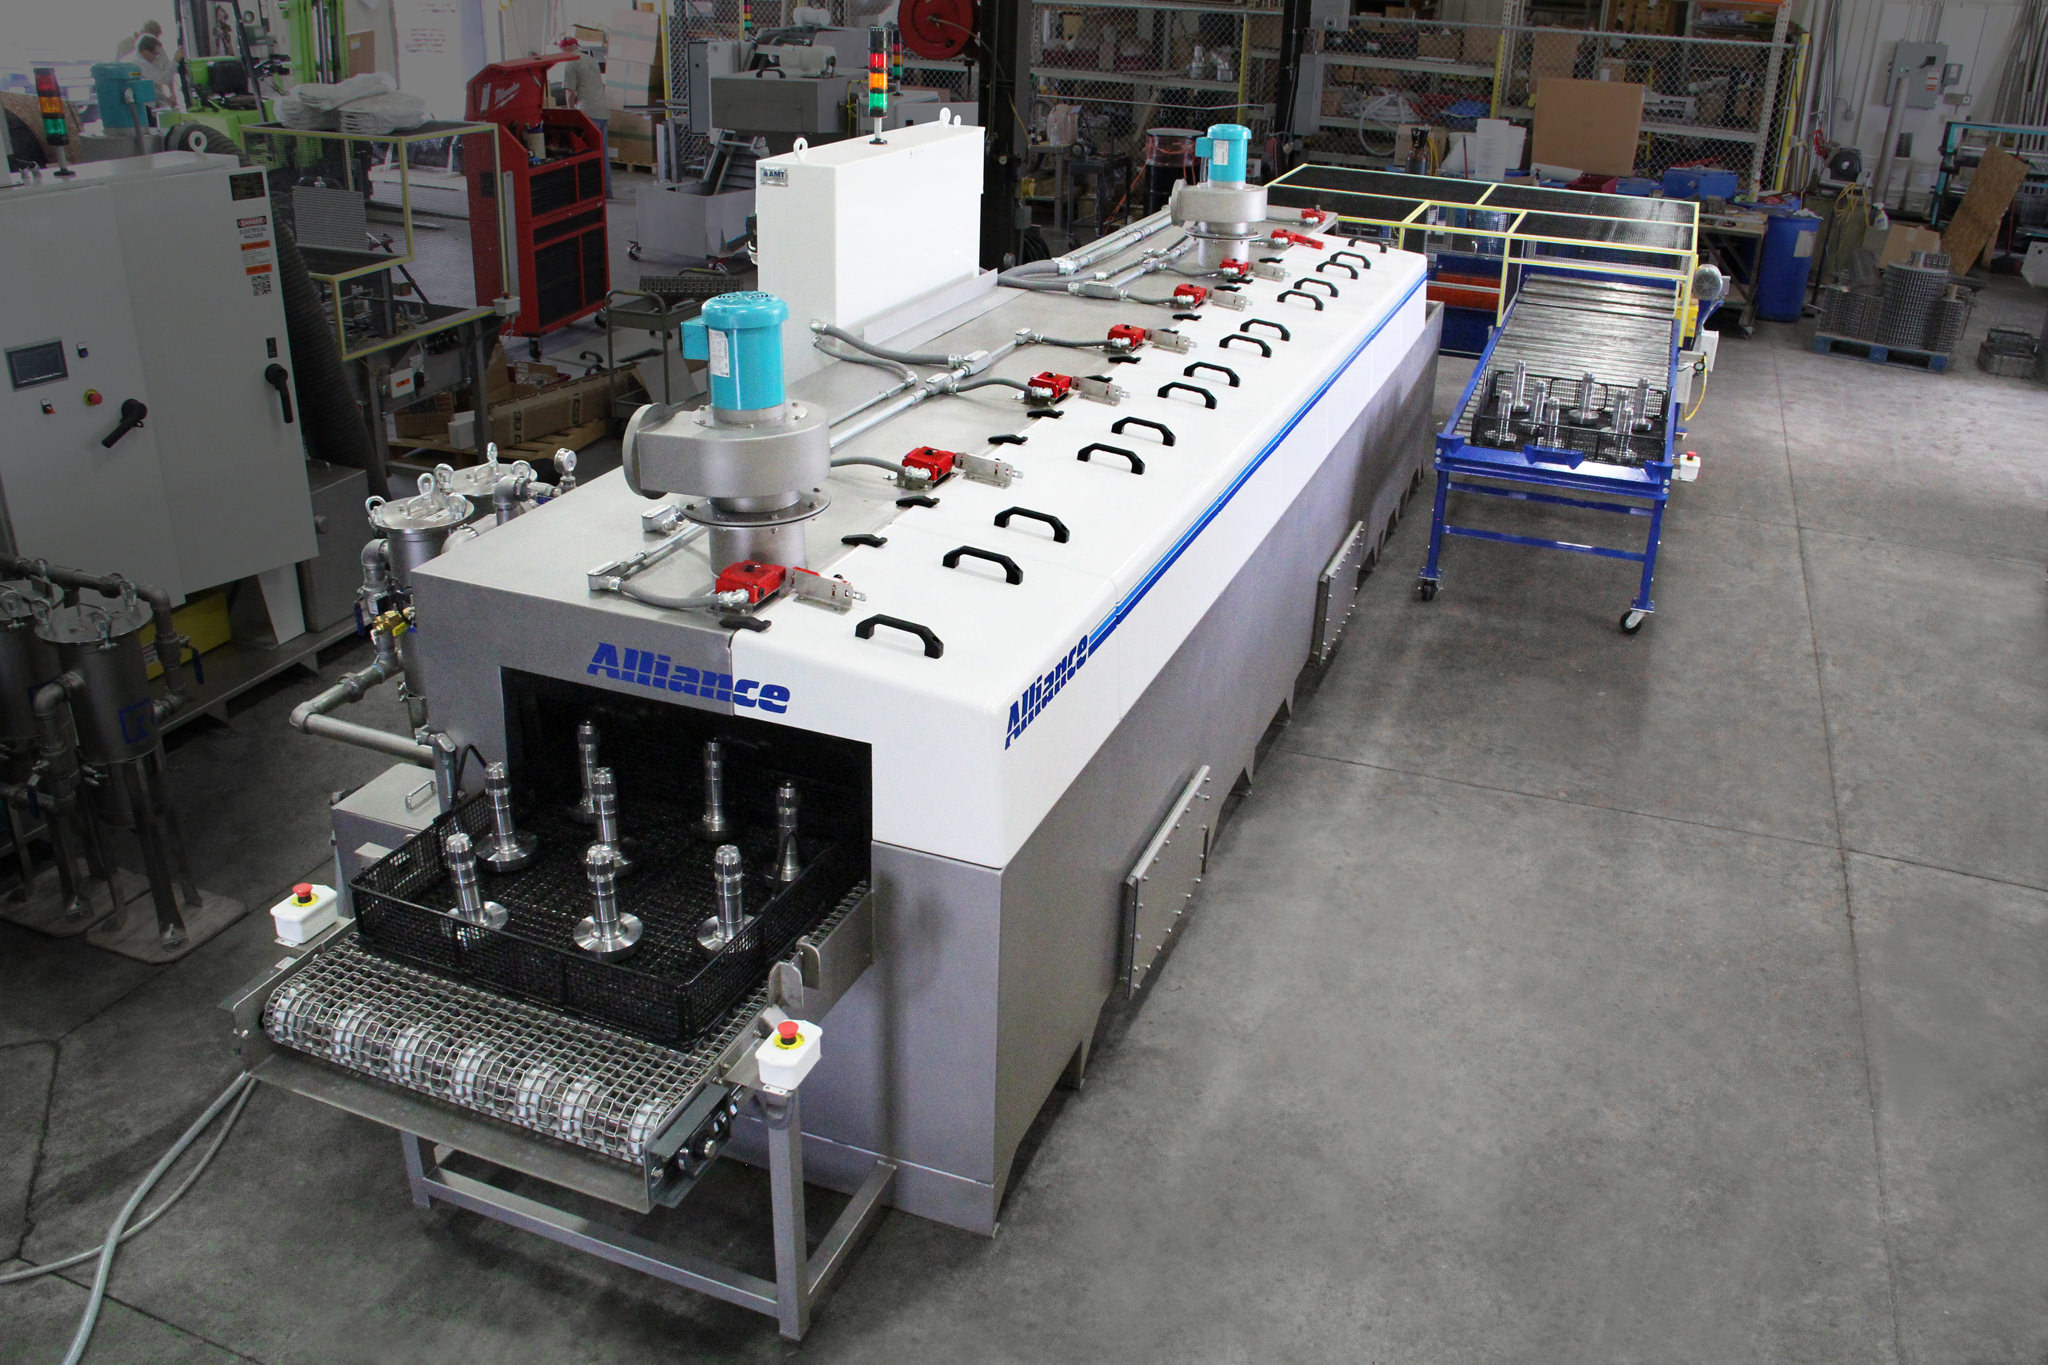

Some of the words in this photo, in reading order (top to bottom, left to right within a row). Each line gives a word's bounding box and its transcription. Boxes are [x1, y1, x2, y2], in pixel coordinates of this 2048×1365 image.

[769, 170, 785, 178] AMT
[587, 642, 790, 714] Alliance
[1005, 634, 1088, 751] Alliance
